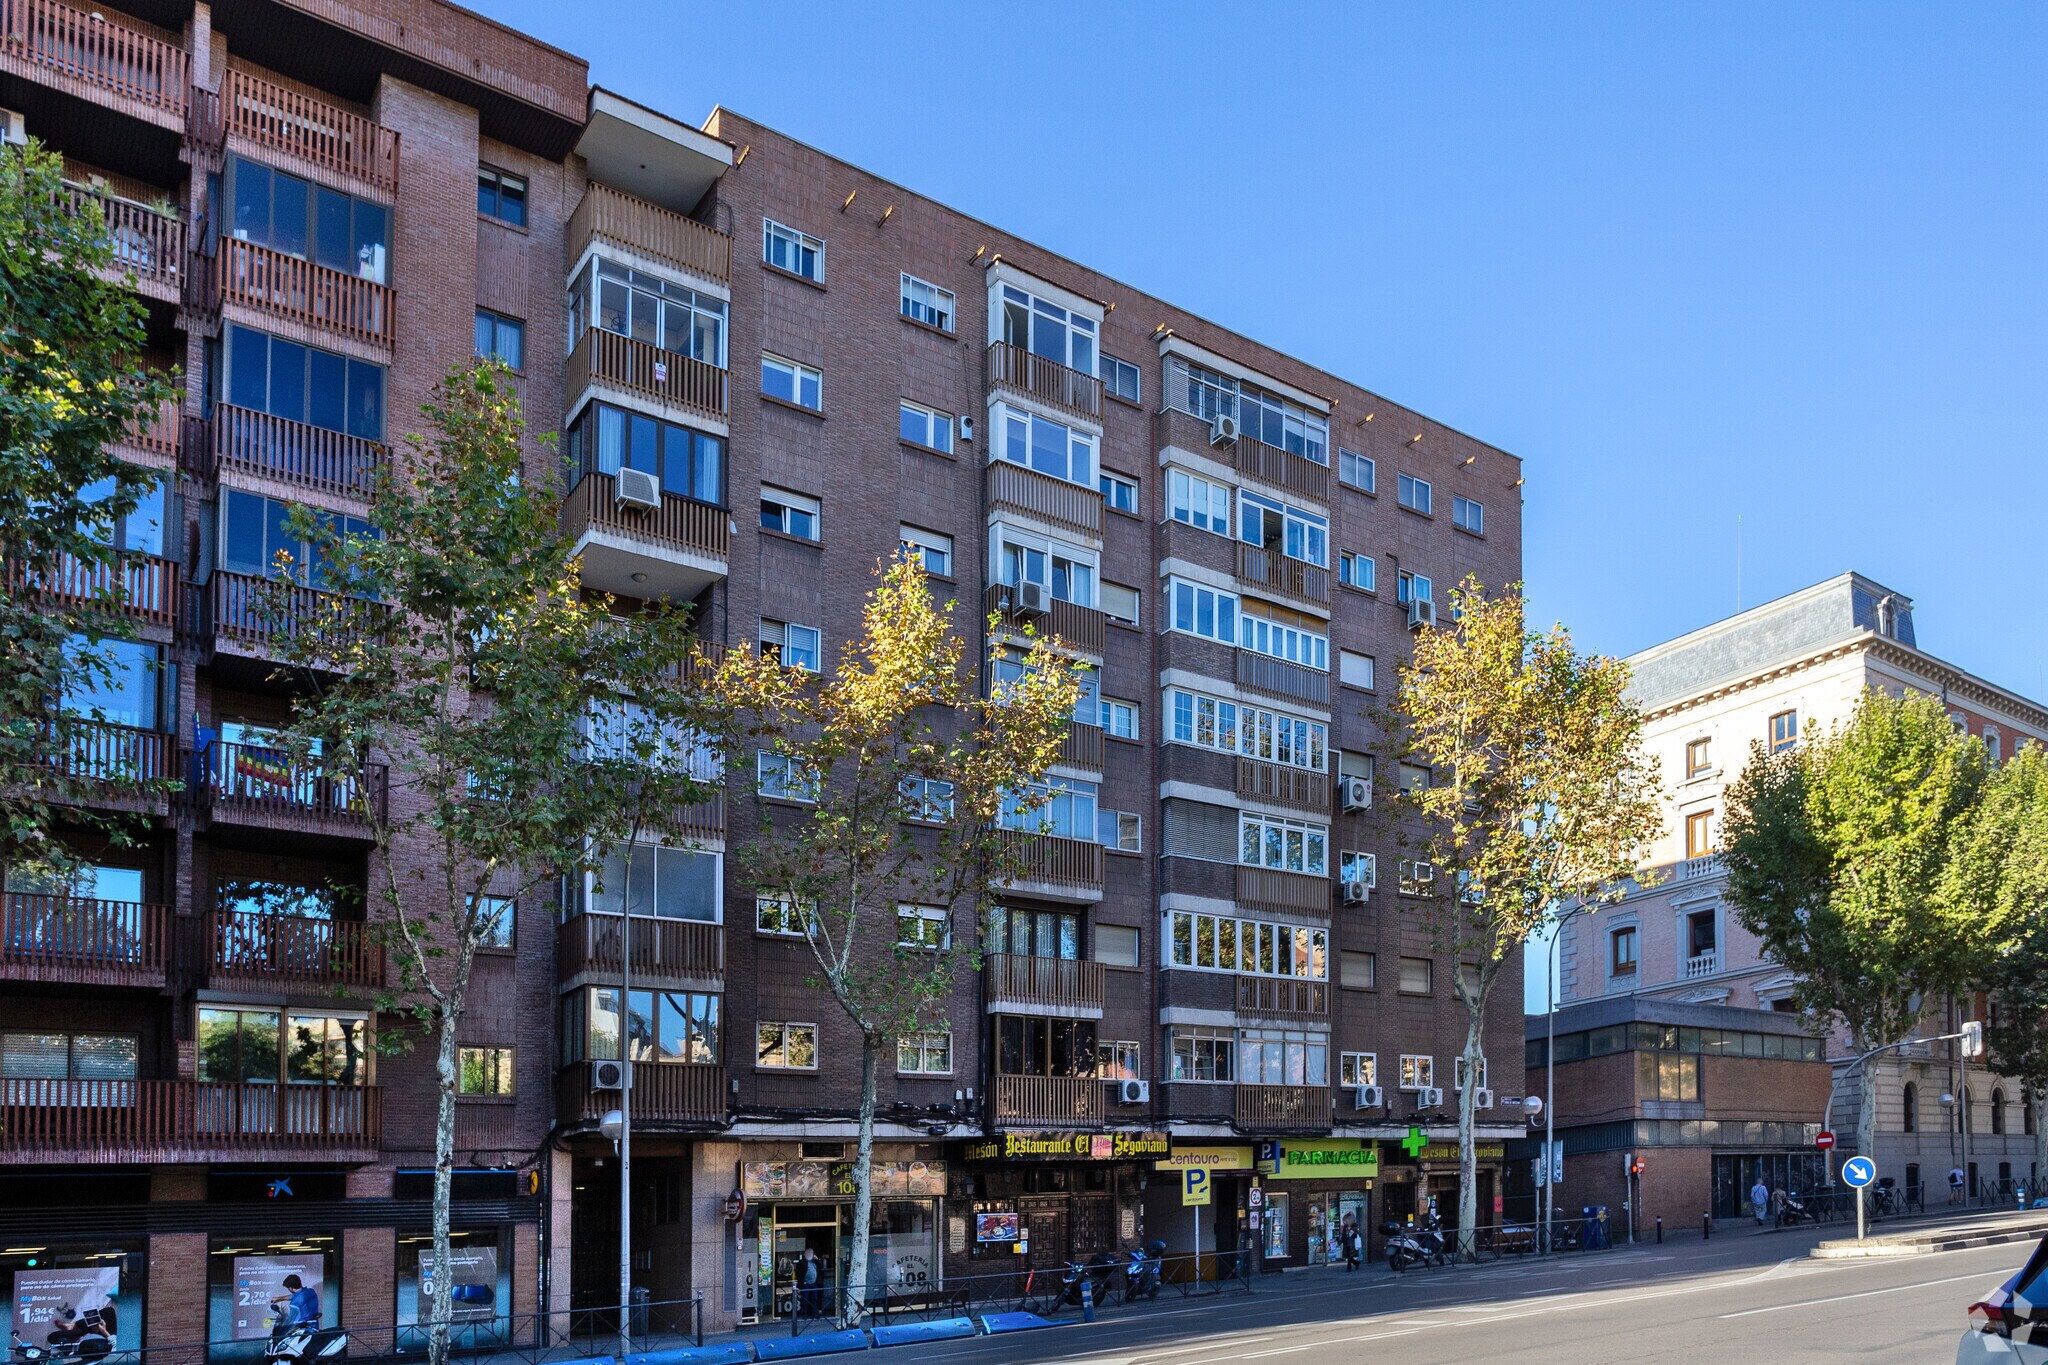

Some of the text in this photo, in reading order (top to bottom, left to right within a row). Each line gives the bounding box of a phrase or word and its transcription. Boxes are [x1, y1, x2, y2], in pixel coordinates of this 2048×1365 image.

[1005, 1134, 1070, 1158] Restaurante
[1074, 1134, 1090, 1153] El
[1114, 1133, 1167, 1156] Segoviano
[1261, 1143, 1271, 1159] P
[1169, 1151, 1220, 1165] centauro
[1287, 1150, 1377, 1165] FARMACIA
[1186, 1168, 1206, 1194] P
